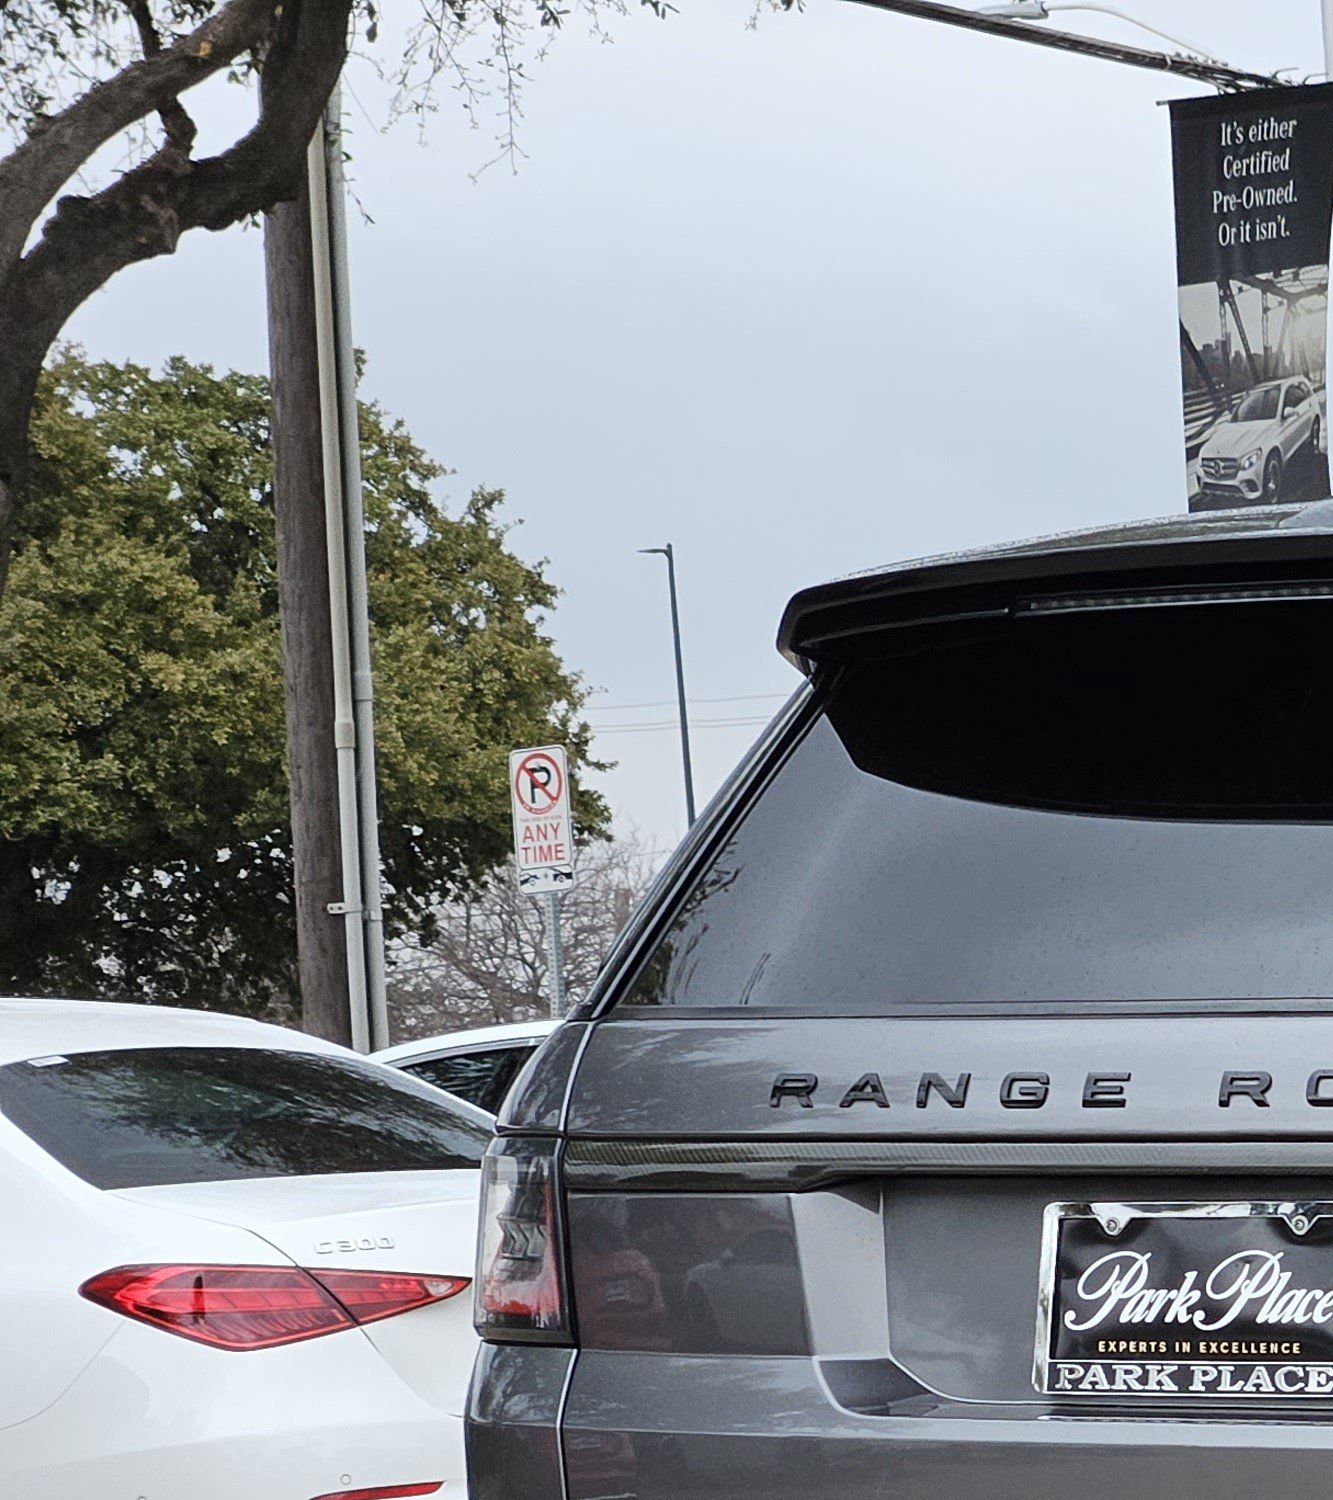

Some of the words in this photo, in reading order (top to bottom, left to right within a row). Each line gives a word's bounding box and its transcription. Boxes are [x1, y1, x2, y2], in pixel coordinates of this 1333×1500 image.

[1220, 120, 1245, 146] It's
[1248, 116, 1298, 143] either
[1222, 147, 1291, 180] Certified
[1212, 179, 1298, 214] Pre-Owned.
[1218, 222, 1238, 247] Or
[1240, 219, 1251, 244] it
[1255, 214, 1290, 241] isn't.
[522, 822, 561, 843] ANY
[521, 843, 566, 864] TIME
[769, 1072, 1132, 1109] RANGE
[1064, 1250, 1201, 1331] Park
[1098, 1340, 1167, 1353] EXPERTS
[1175, 1341, 1191, 1353] IN
[1199, 1341, 1301, 1354] EXCELLENCE
[1054, 1364, 1179, 1391] PARK
